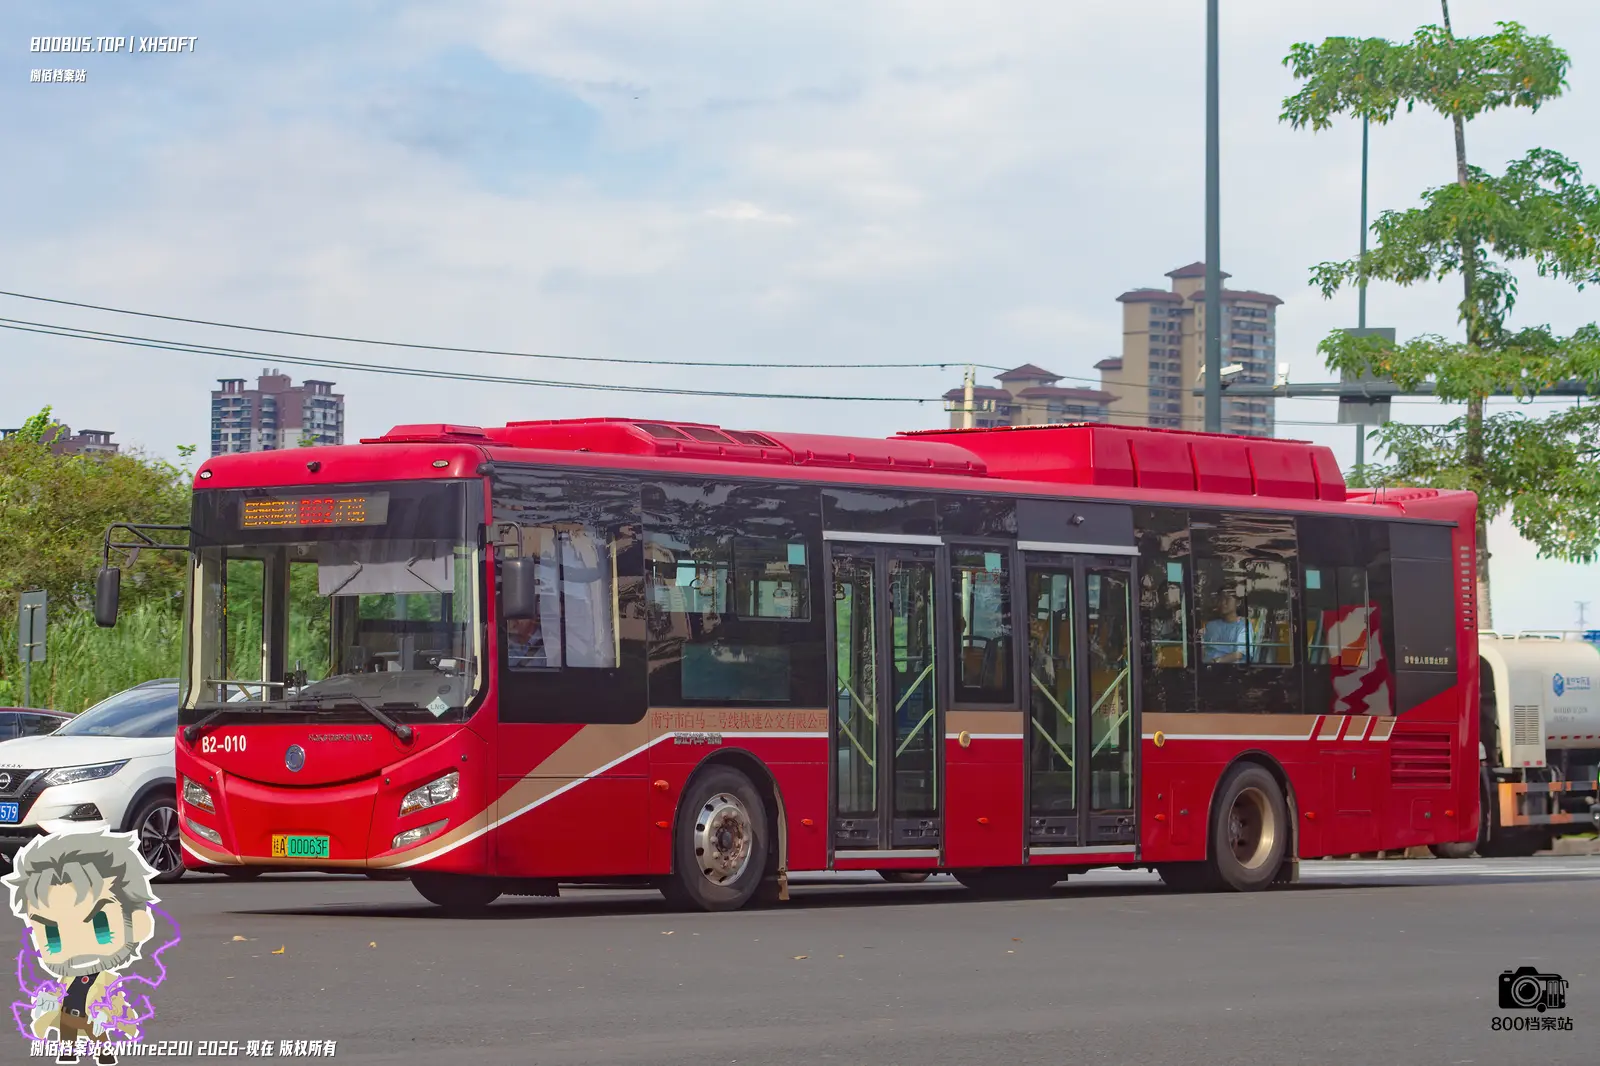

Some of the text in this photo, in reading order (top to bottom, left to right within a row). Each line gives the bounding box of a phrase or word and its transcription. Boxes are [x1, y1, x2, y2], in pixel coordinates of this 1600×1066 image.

[430, 703, 446, 711] LNG
[651, 712, 828, 730] 南宁市白马二号线快速公交有限公司
[202, 735, 247, 753] B2-010
